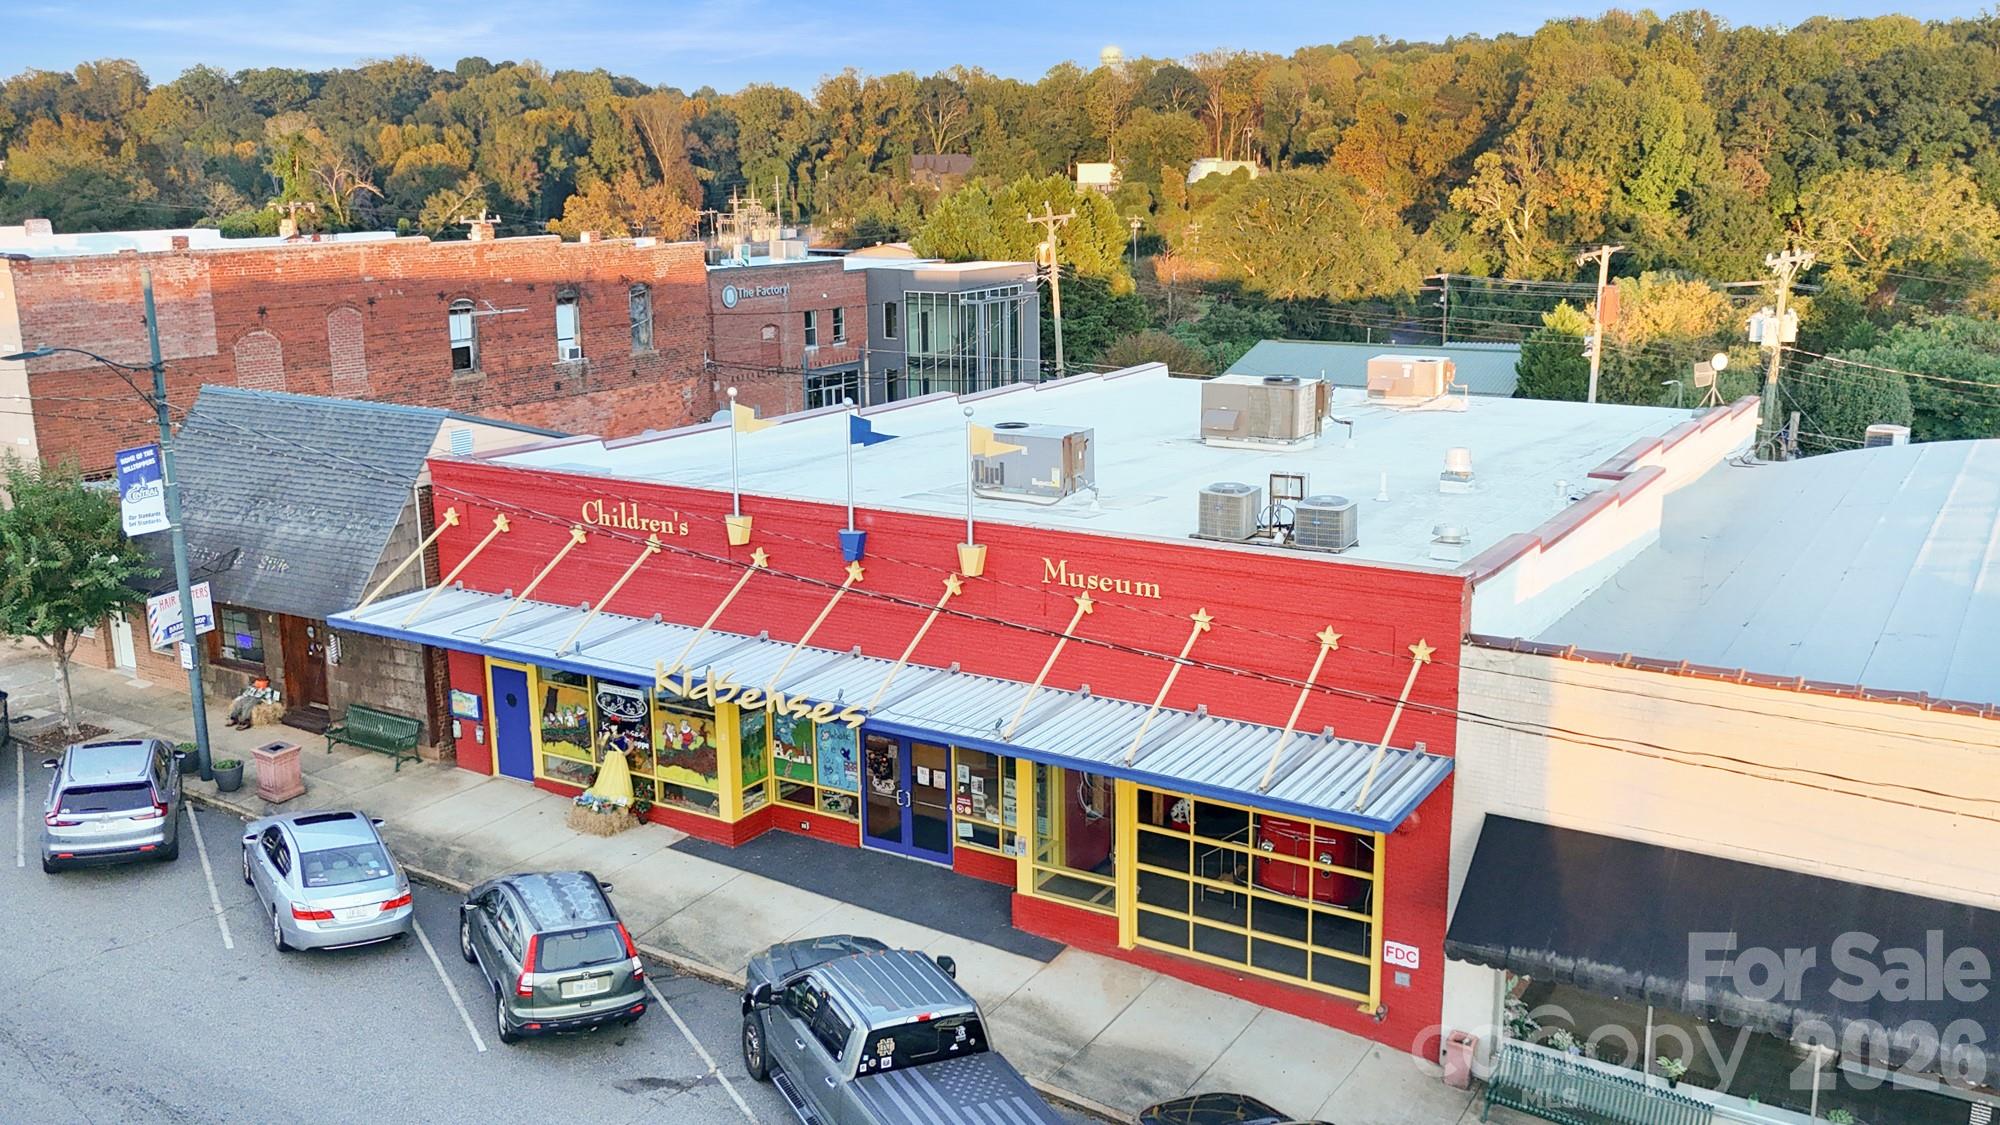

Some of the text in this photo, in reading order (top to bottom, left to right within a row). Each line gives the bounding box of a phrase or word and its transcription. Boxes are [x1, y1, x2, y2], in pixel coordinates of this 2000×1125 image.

[737, 287, 753, 299] The
[120, 449, 154, 465] HOME OF THE
[582, 499, 689, 536] Children's
[1041, 557, 1162, 599] Museum
[159, 595, 177, 612] HAIR
[655, 659, 866, 729] KidSenses
[1386, 945, 1417, 963] FDC
